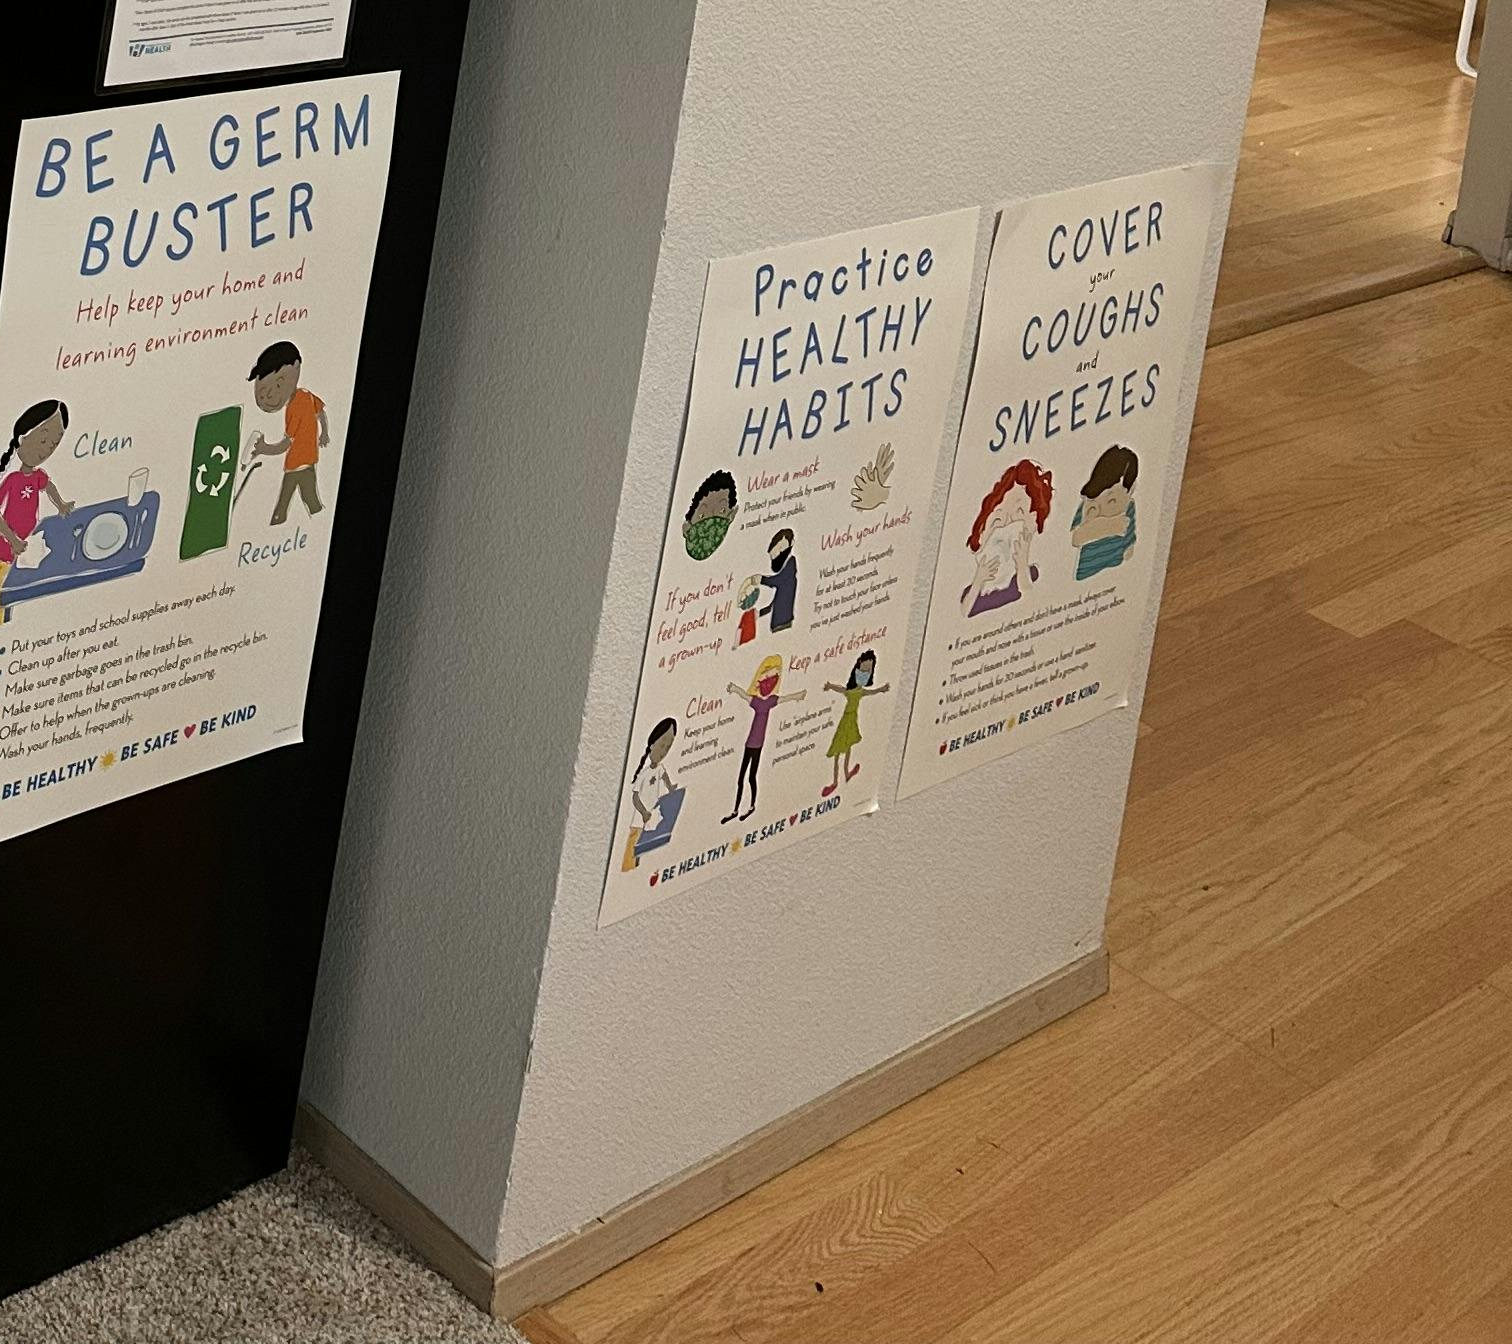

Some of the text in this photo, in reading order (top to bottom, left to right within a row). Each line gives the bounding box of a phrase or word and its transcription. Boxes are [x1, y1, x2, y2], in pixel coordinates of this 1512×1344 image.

[35, 93, 370, 198] BE A GERM
[80, 181, 314, 277] BUSTER
[1047, 200, 1165, 273] COVER
[76, 257, 306, 328] Help keep your home and
[755, 245, 935, 318] Practice
[1088, 265, 1116, 293] your
[56, 302, 309, 372] learning environment clean
[733, 296, 934, 391] HEALTHY
[1021, 282, 1166, 363] COUGHS
[1076, 351, 1100, 374] and
[73, 430, 133, 460] Clean
[737, 367, 910, 458] HABITS
[988, 363, 1162, 455] SNEEZES
[747, 457, 820, 493] Wear a mask
[237, 529, 308, 569] Recycle
[821, 509, 913, 551] Wash your hands
[2, 703, 257, 801] BE HEALTHY BE SAFE BE KIND
